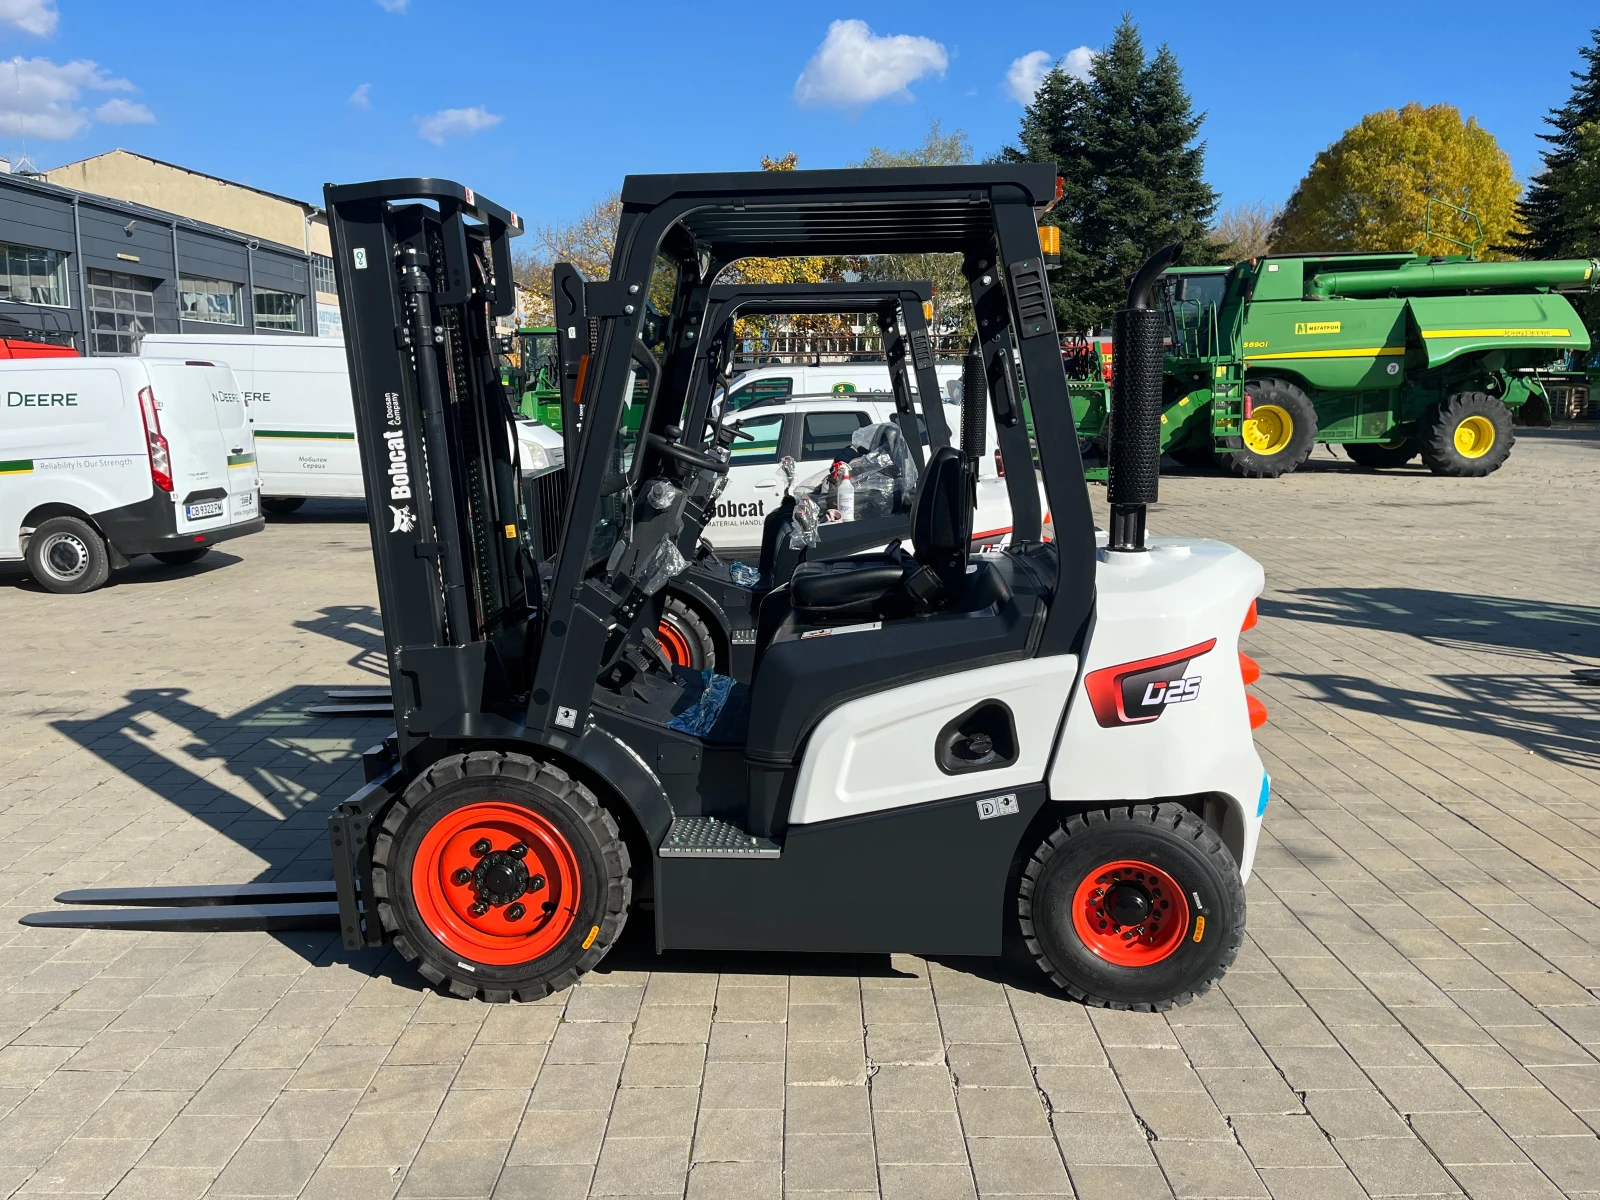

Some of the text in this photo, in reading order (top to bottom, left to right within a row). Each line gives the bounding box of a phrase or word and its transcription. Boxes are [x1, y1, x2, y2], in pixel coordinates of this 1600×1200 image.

[241, 392, 271, 402] ERE
[384, 392, 394, 419] Doosan
[391, 392, 401, 426] Company
[40, 458, 133, 471] Reliability Is Our Strength
[383, 430, 411, 500] Bobcat
[714, 500, 764, 518] obcat
[1141, 675, 1202, 706] D25
